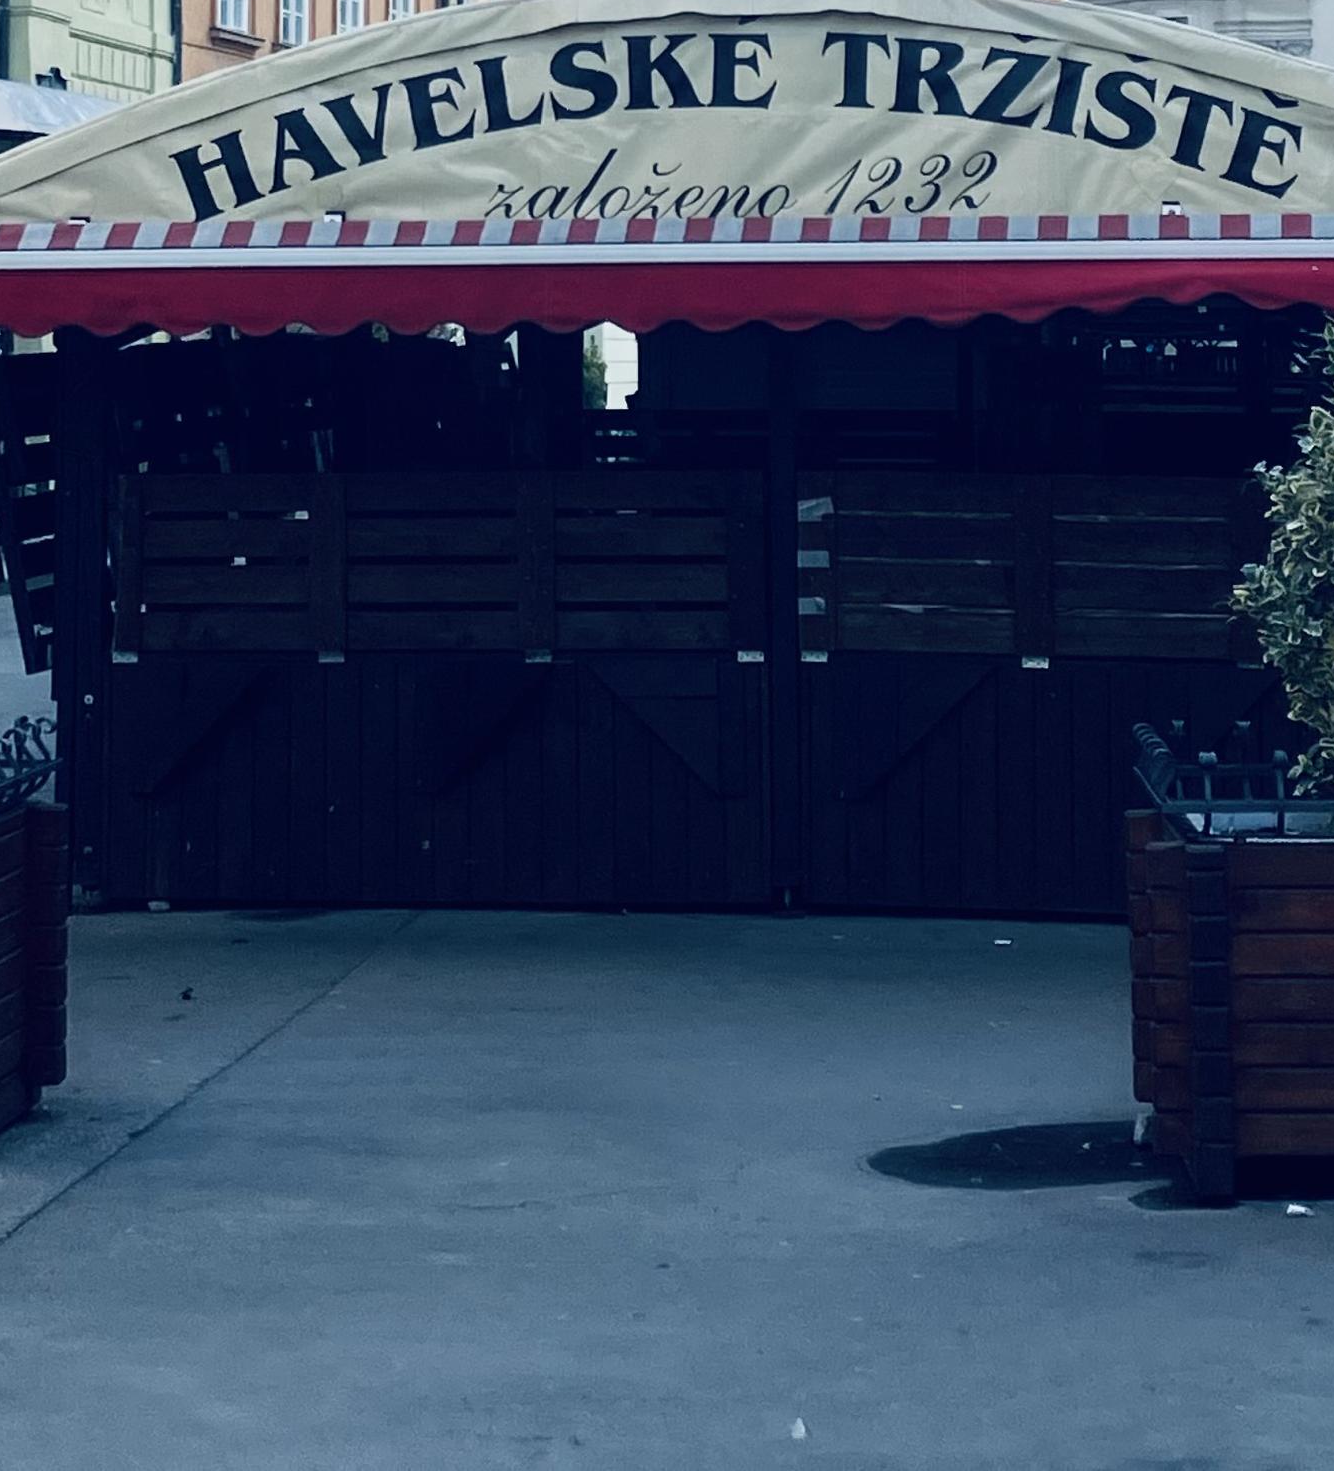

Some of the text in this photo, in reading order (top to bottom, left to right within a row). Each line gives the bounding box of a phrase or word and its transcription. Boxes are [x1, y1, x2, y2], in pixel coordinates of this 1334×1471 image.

[169, 15, 1304, 222] HAVELSKÉ TRŽIŠTĚ
[484, 148, 999, 220] založeno 1232
